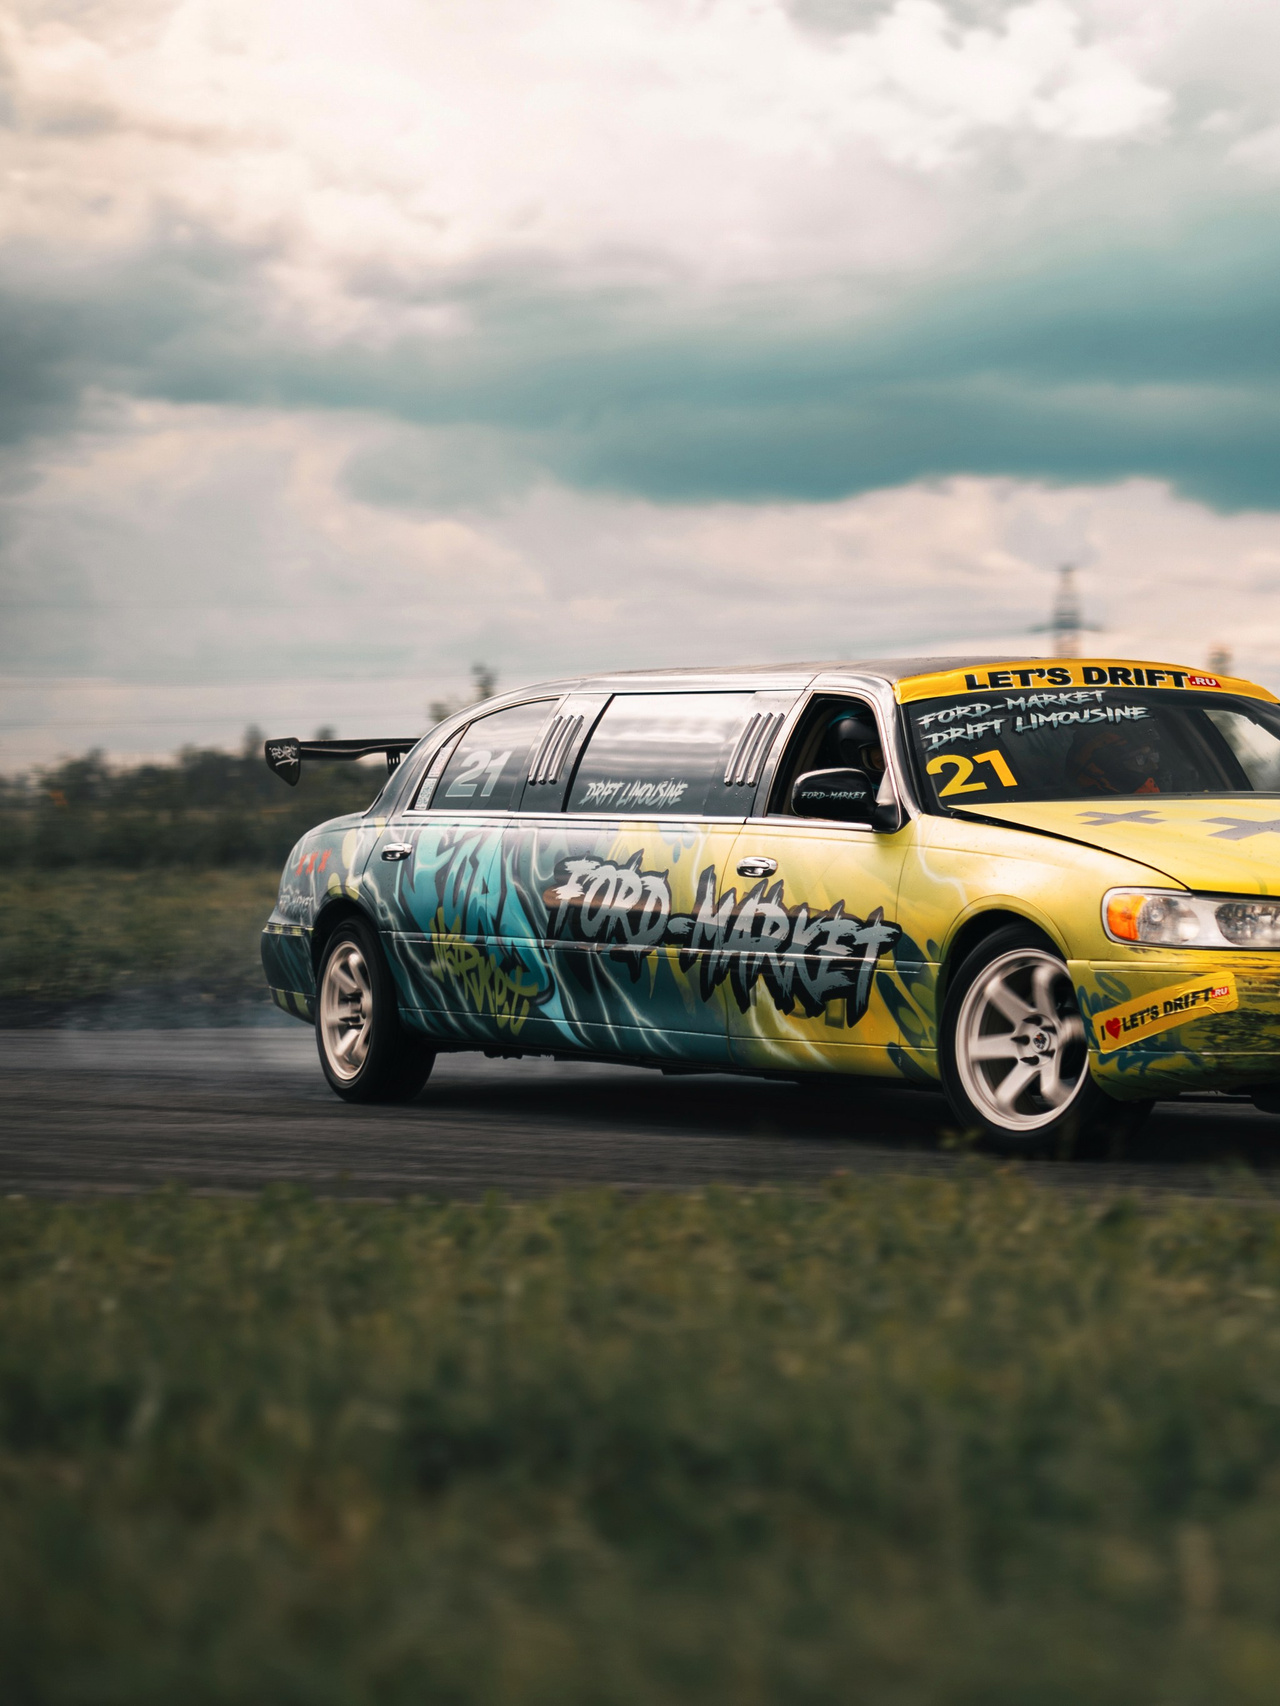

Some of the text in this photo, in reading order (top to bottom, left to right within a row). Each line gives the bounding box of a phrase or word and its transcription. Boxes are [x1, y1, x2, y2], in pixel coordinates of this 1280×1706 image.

[964, 667, 1072, 690] LET'S
[916, 690, 1107, 730] FORD-MARKET
[920, 706, 1152, 751] DRIFT LIMOUSINE
[445, 750, 513, 797] 21
[578, 777, 689, 809] DRIFT LIMOUSINE
[926, 750, 1018, 797] 21
[801, 791, 867, 800] FORD-MARKET
[549, 852, 900, 1010] FORD-MARKET
[1121, 1005, 1159, 1032] LET'S
